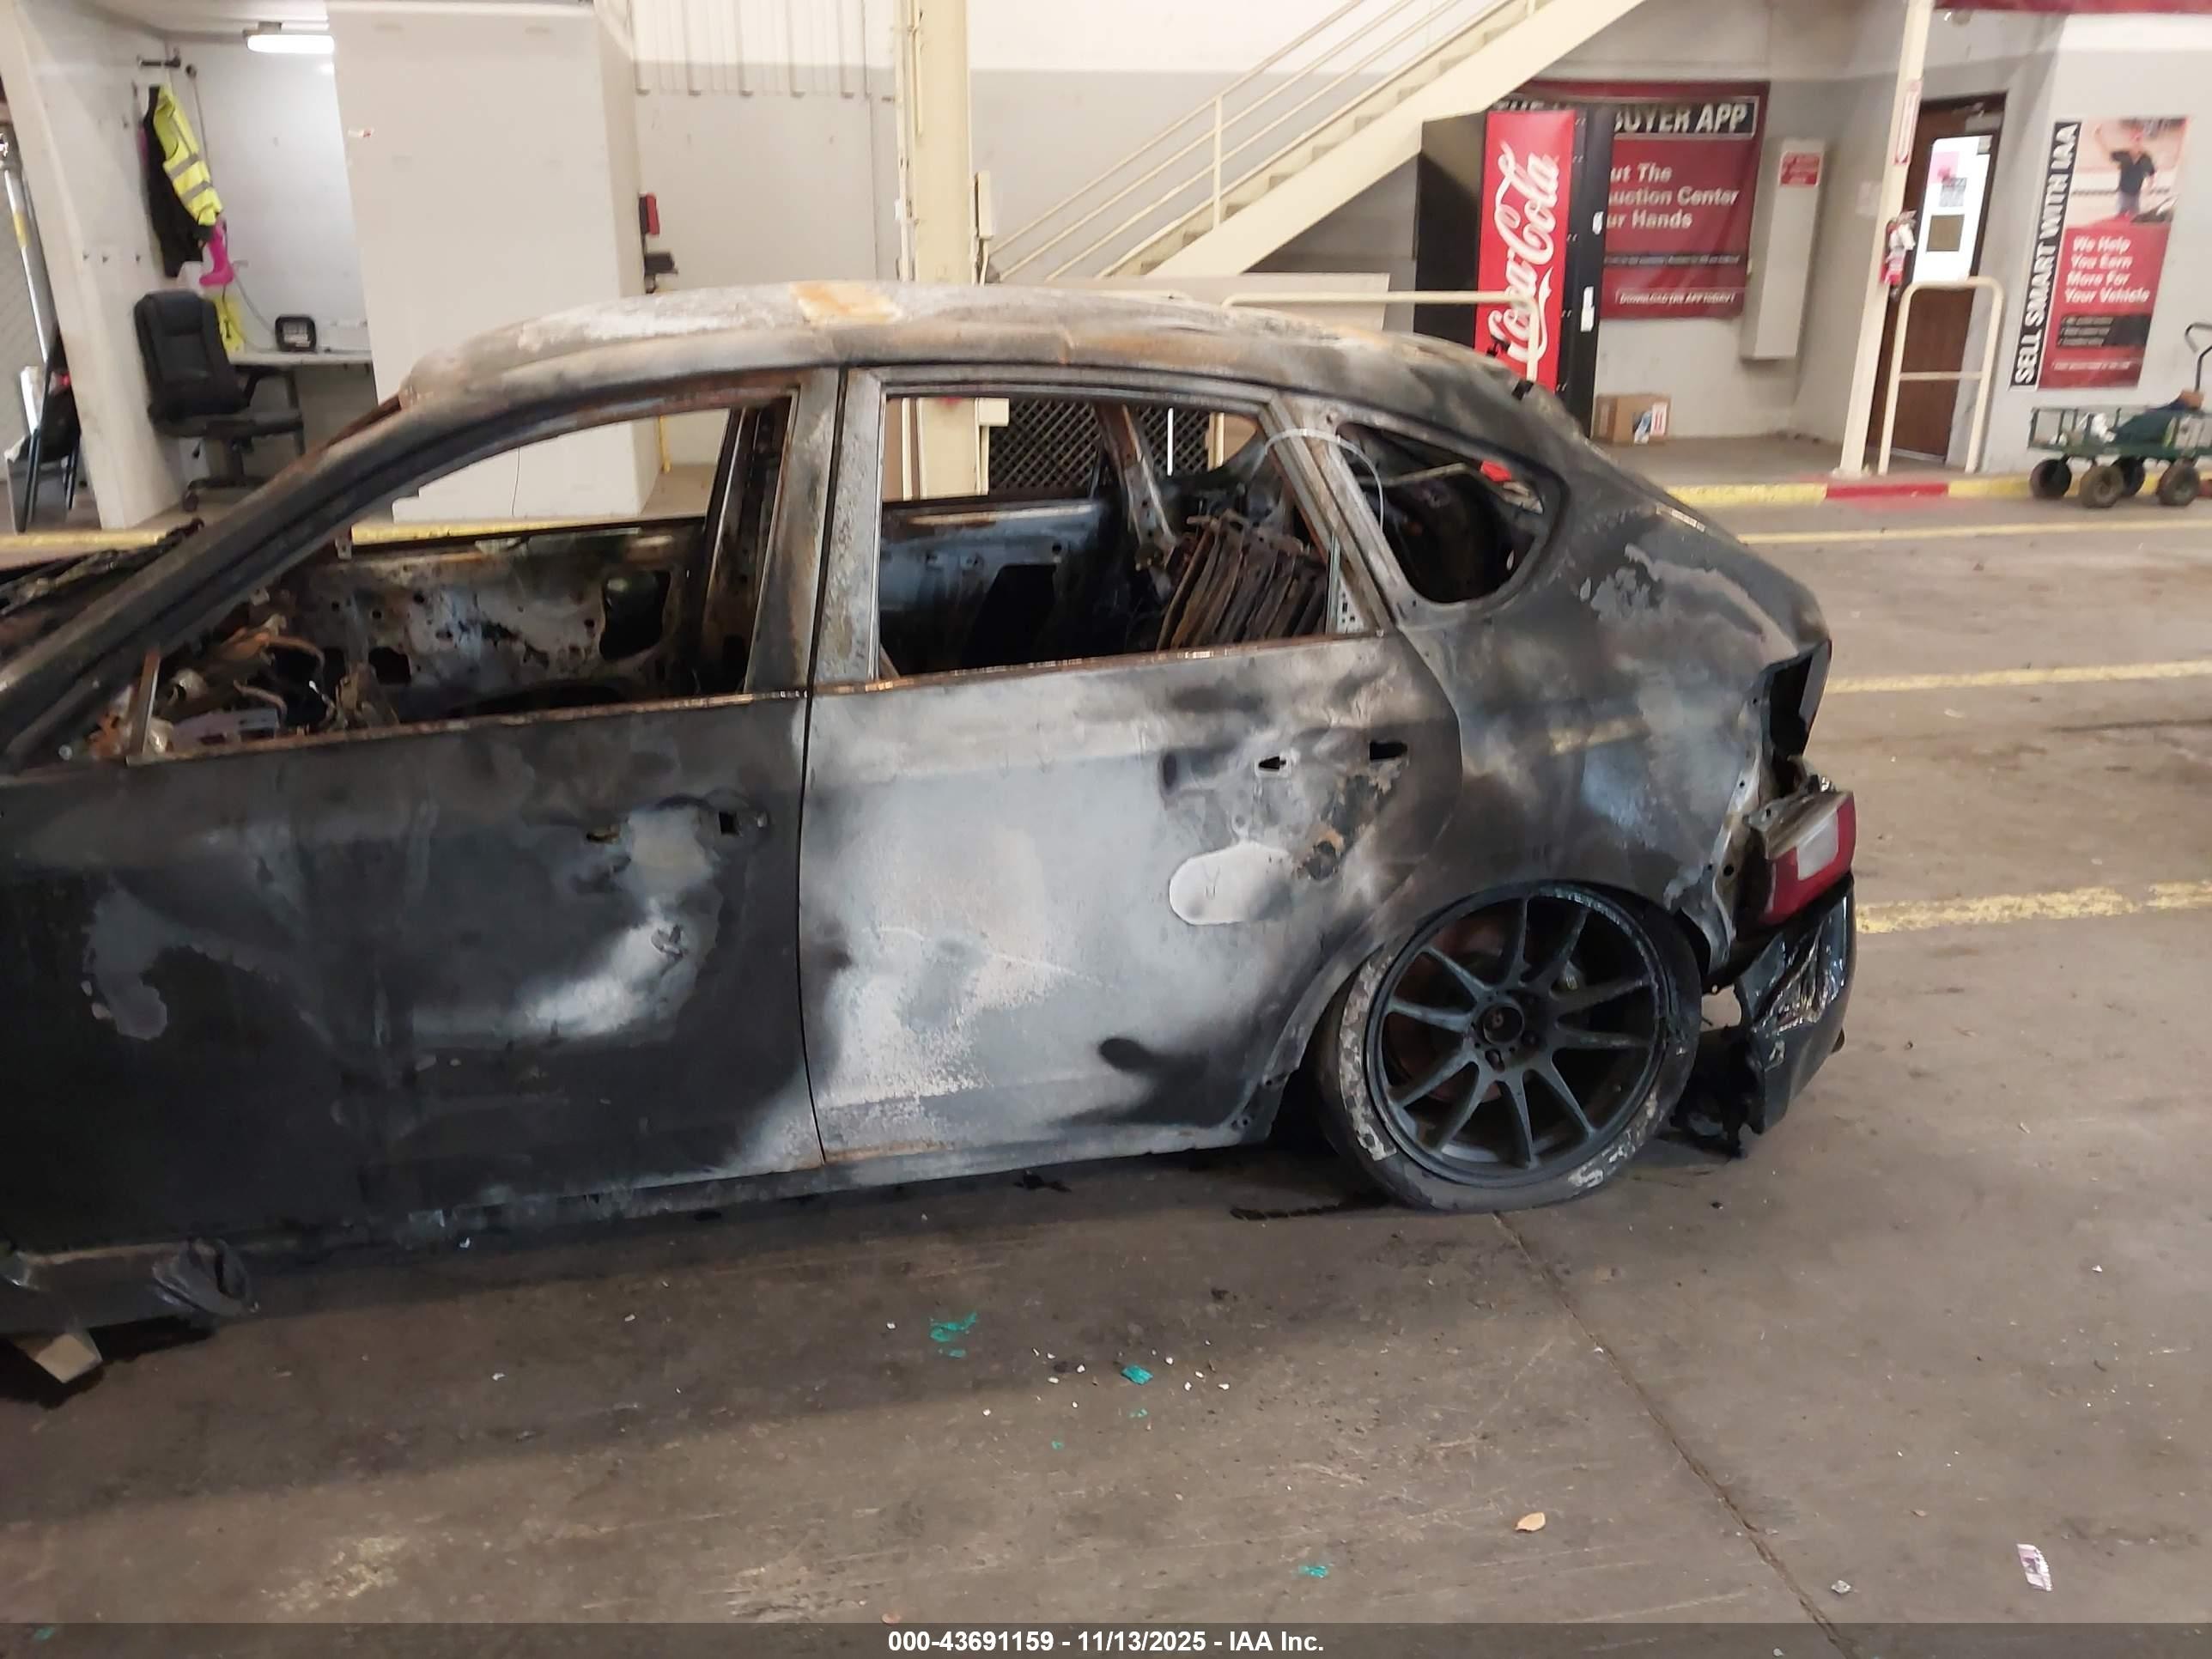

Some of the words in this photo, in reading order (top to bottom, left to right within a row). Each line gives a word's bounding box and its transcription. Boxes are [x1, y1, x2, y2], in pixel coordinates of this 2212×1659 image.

[1694, 103, 1747, 133] APP
[2051, 123, 2078, 169] IAA
[1638, 162, 1673, 183] The
[1677, 185, 1740, 206] Center
[2039, 173, 2069, 240] WITH
[1632, 209, 1692, 229] Hands
[2025, 241, 2056, 327] SMART
[2014, 329, 2042, 383] SELL
